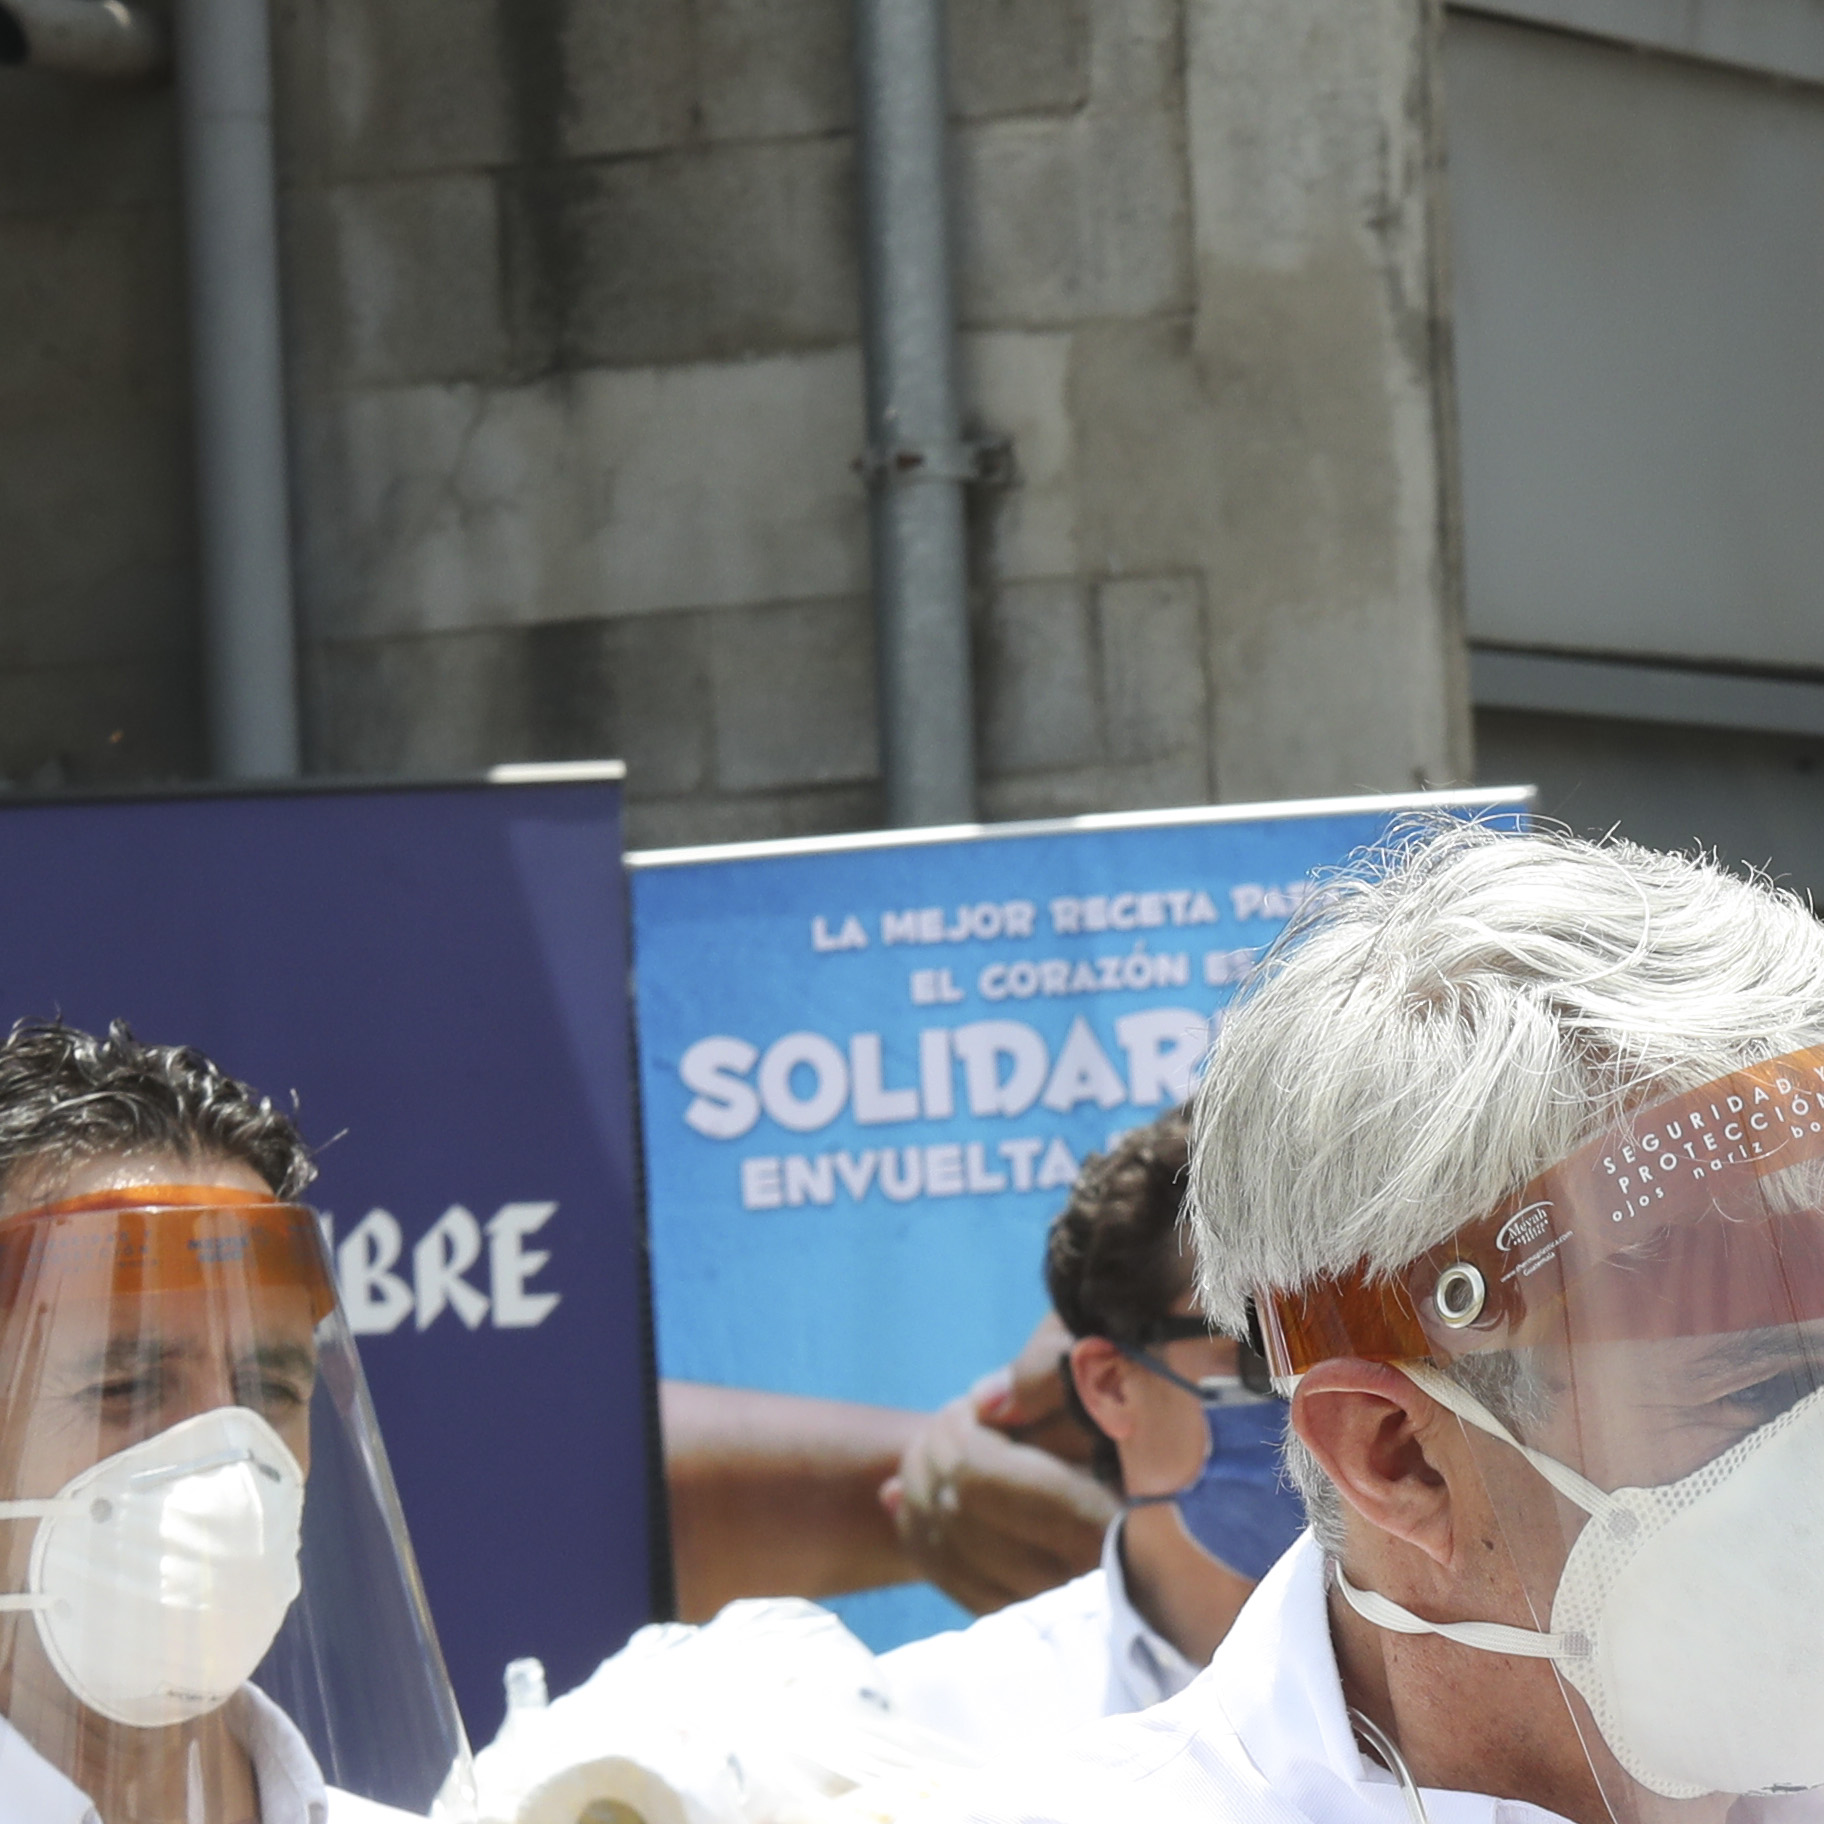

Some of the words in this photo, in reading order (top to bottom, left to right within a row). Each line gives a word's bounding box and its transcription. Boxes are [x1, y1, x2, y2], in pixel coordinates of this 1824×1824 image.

[812, 915, 868, 953] LA
[881, 900, 1036, 947] MEJOR
[1051, 890, 1218, 935] RECETA
[911, 968, 963, 1006] EL
[978, 941, 1190, 1001] CORAZÓN
[679, 1006, 1215, 1141] SOLIDAR
[1603, 1077, 1793, 1175] SEGURIDAD
[742, 1138, 1081, 1212] ENVUELTA
[1611, 1186, 1664, 1223] ojos
[1692, 1140, 1763, 1180] nariz
[316, 1201, 562, 1337] BRE
